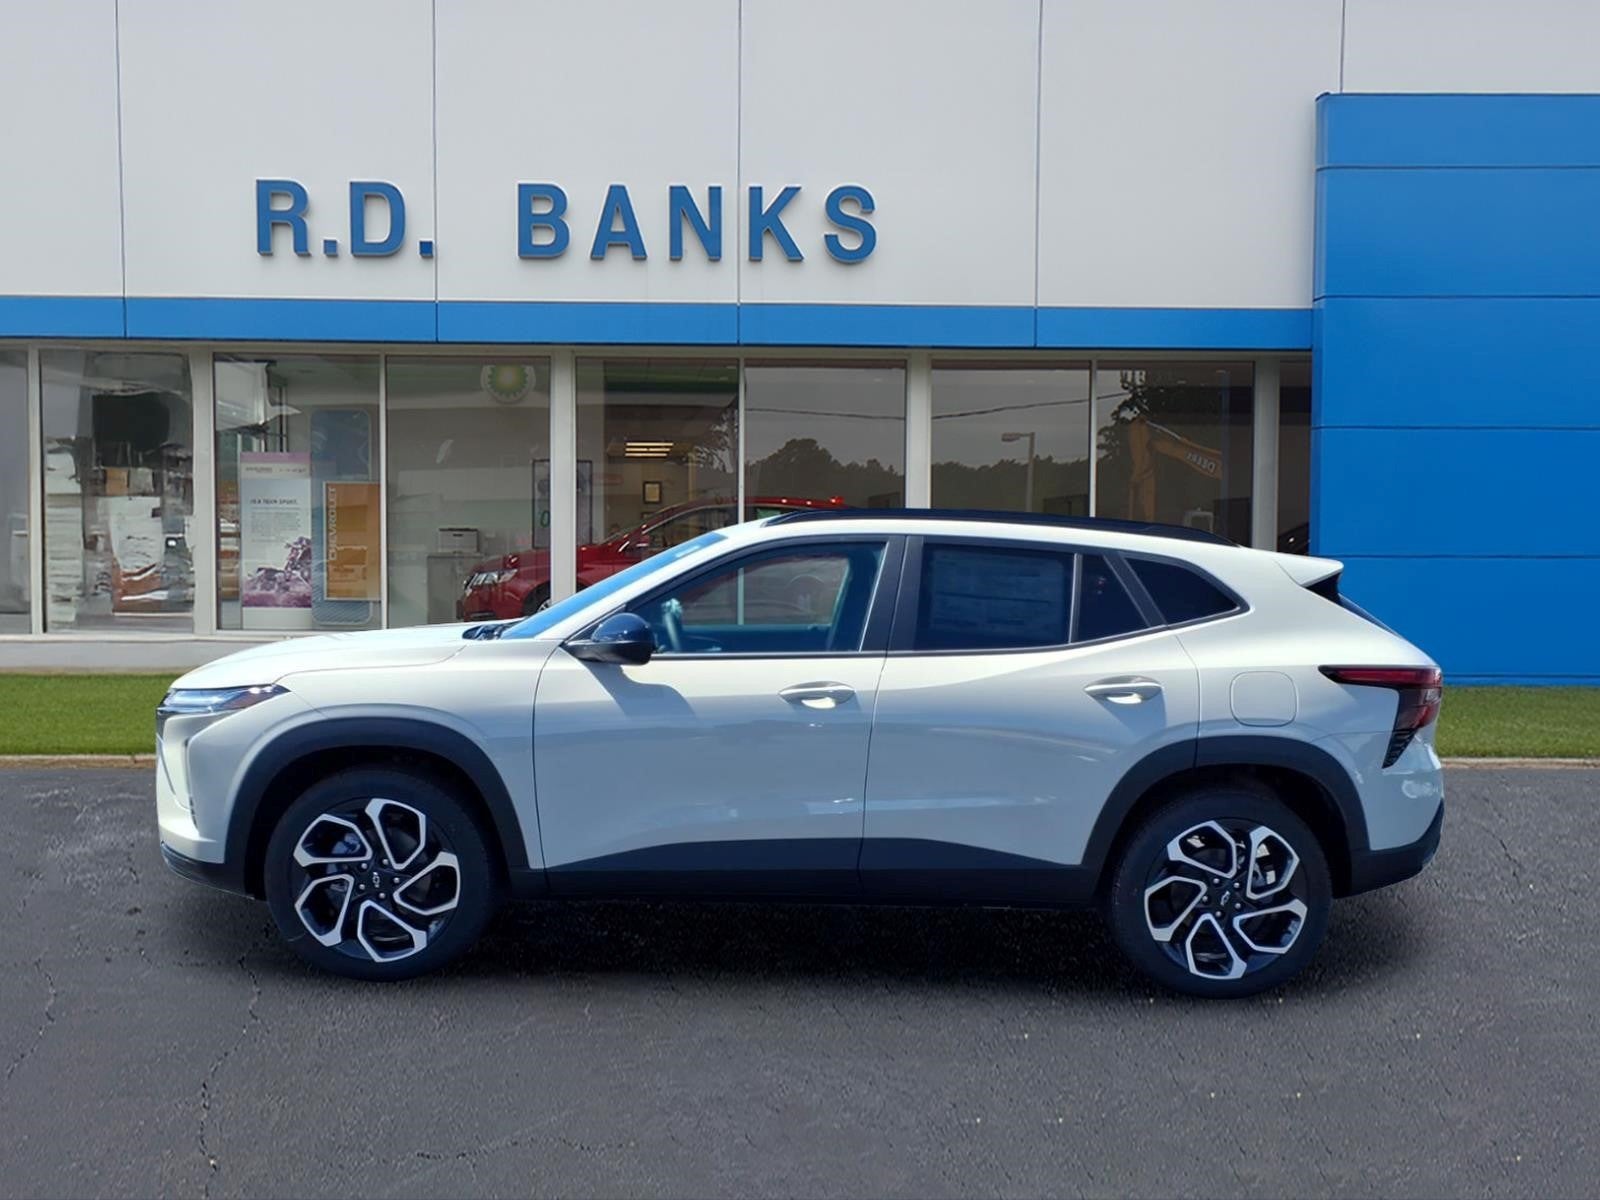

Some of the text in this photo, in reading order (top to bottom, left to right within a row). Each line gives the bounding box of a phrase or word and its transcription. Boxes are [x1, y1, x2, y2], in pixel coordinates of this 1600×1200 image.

[256, 179, 877, 263] R.D. BANKS
[328, 487, 337, 560] CHEVROLET
